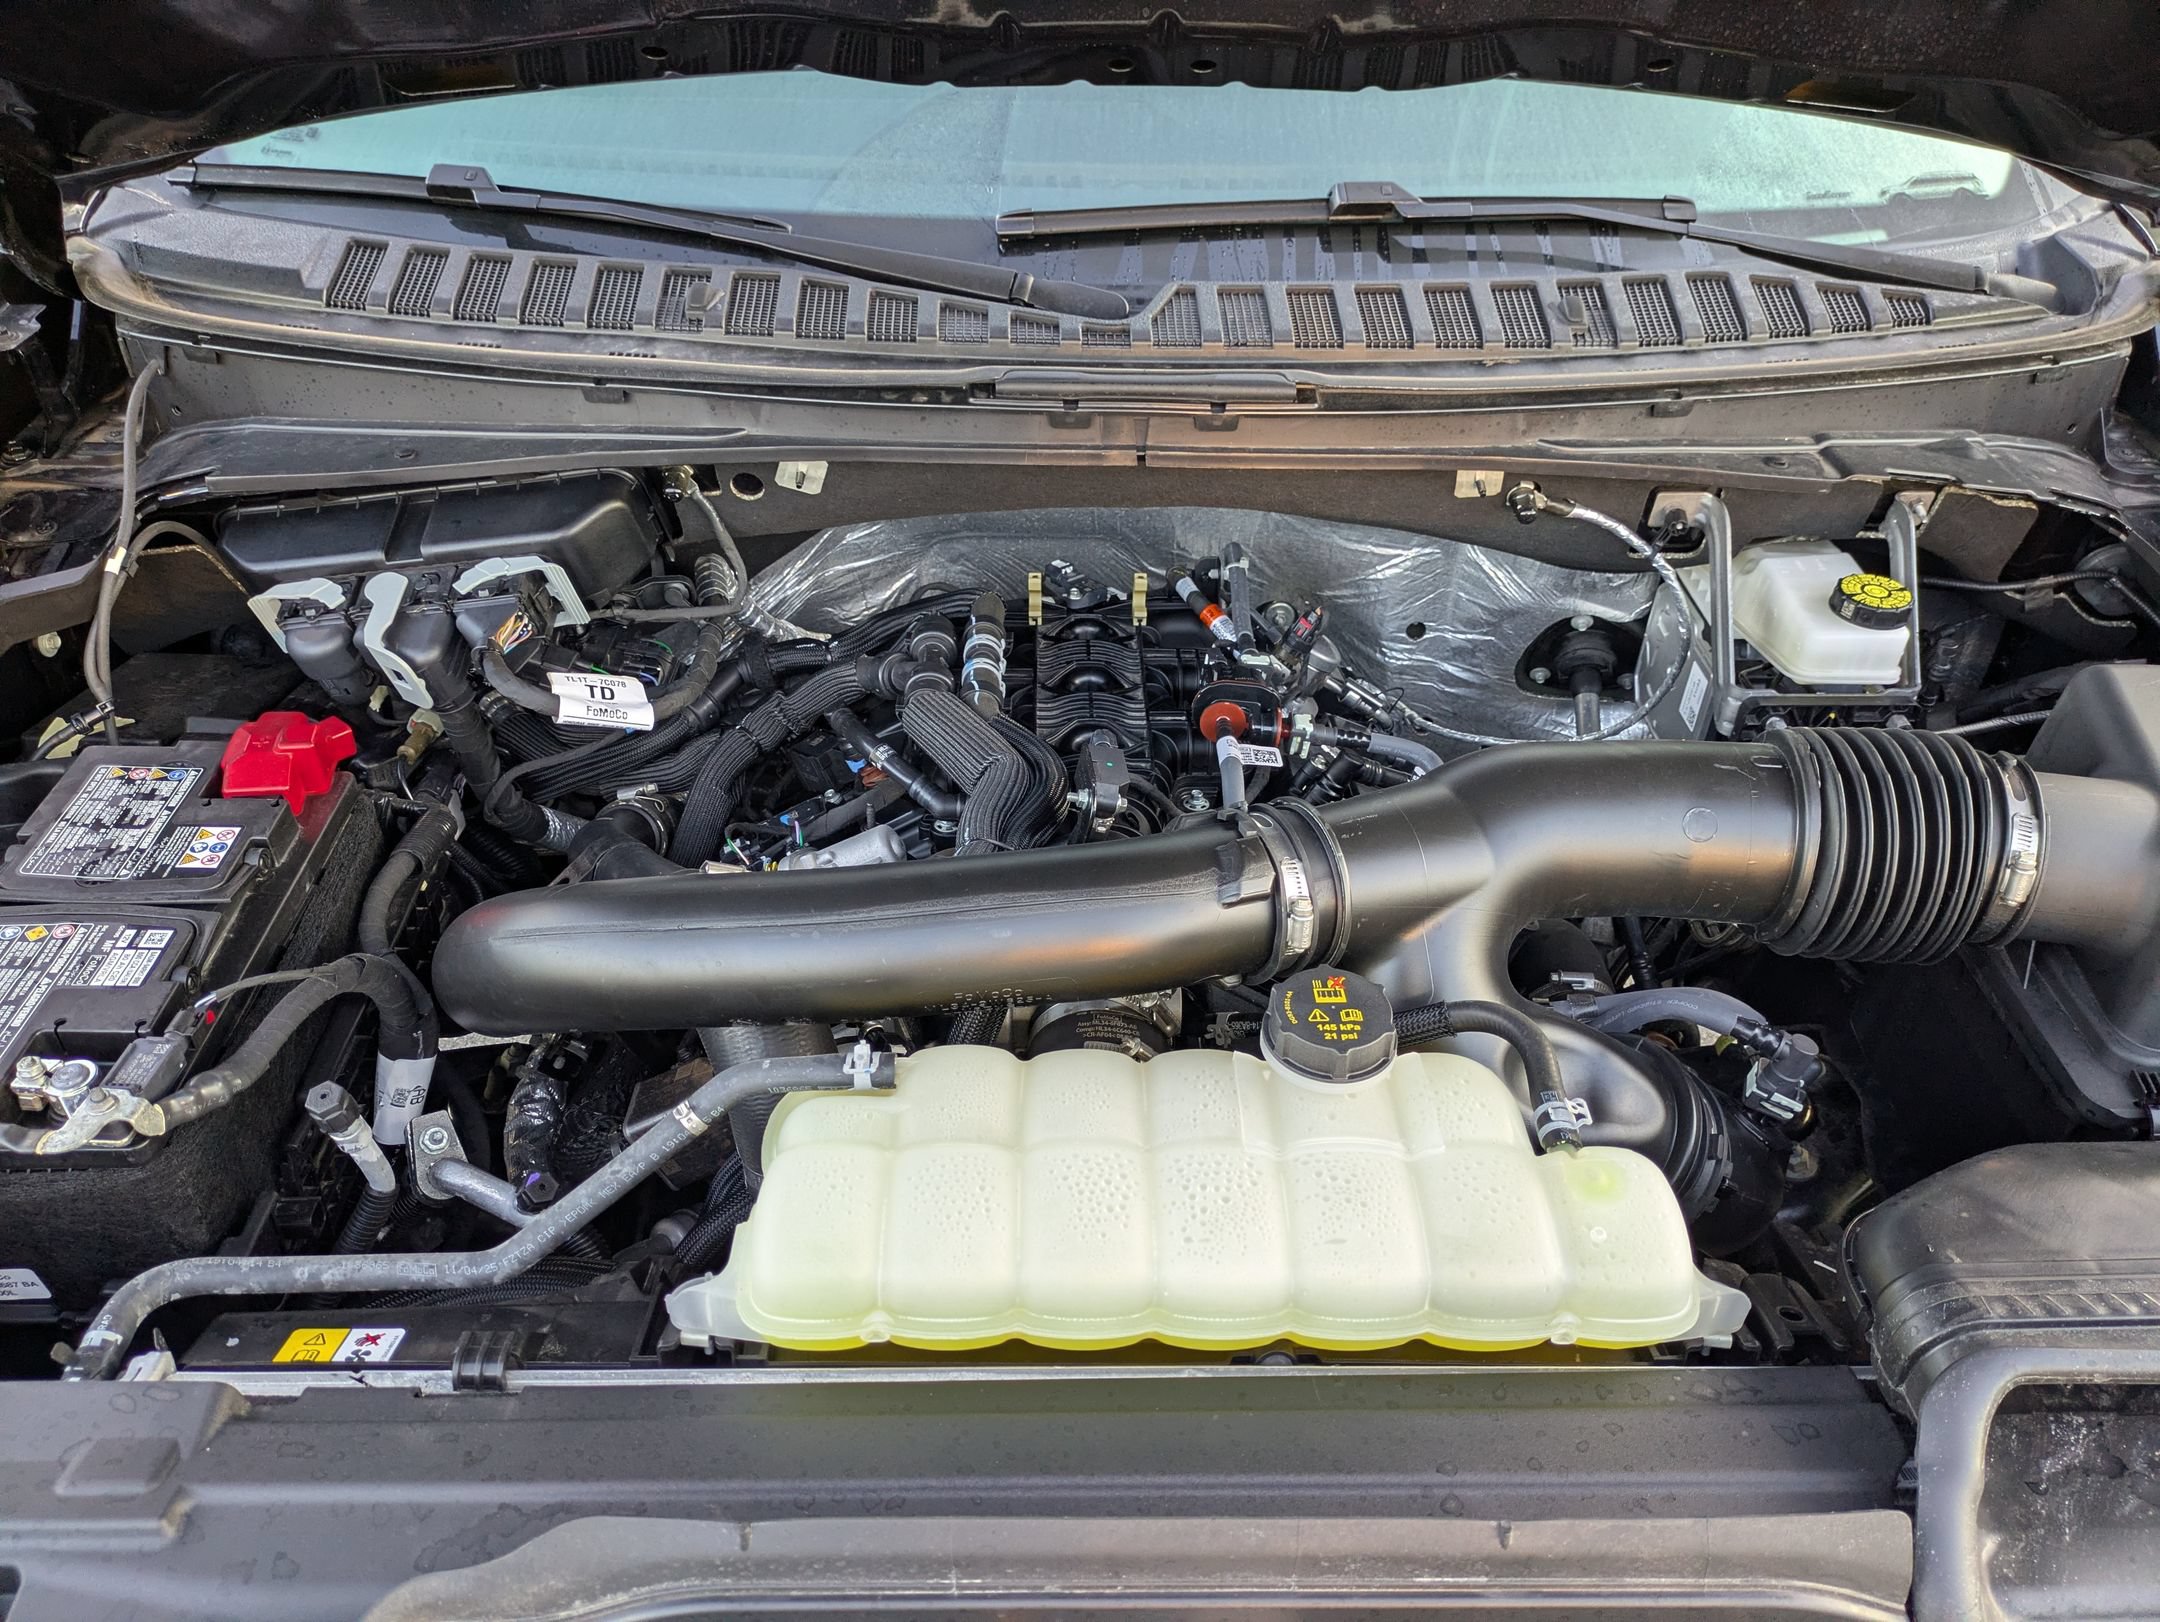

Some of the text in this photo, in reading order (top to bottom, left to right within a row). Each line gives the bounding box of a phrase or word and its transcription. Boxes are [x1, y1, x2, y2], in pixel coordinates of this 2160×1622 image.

[584, 684, 615, 700] TD
[586, 705, 628, 720] FoMoCo
[1316, 1023, 1361, 1031] 145 kPa
[1324, 1032, 1358, 1041] 21 psi
